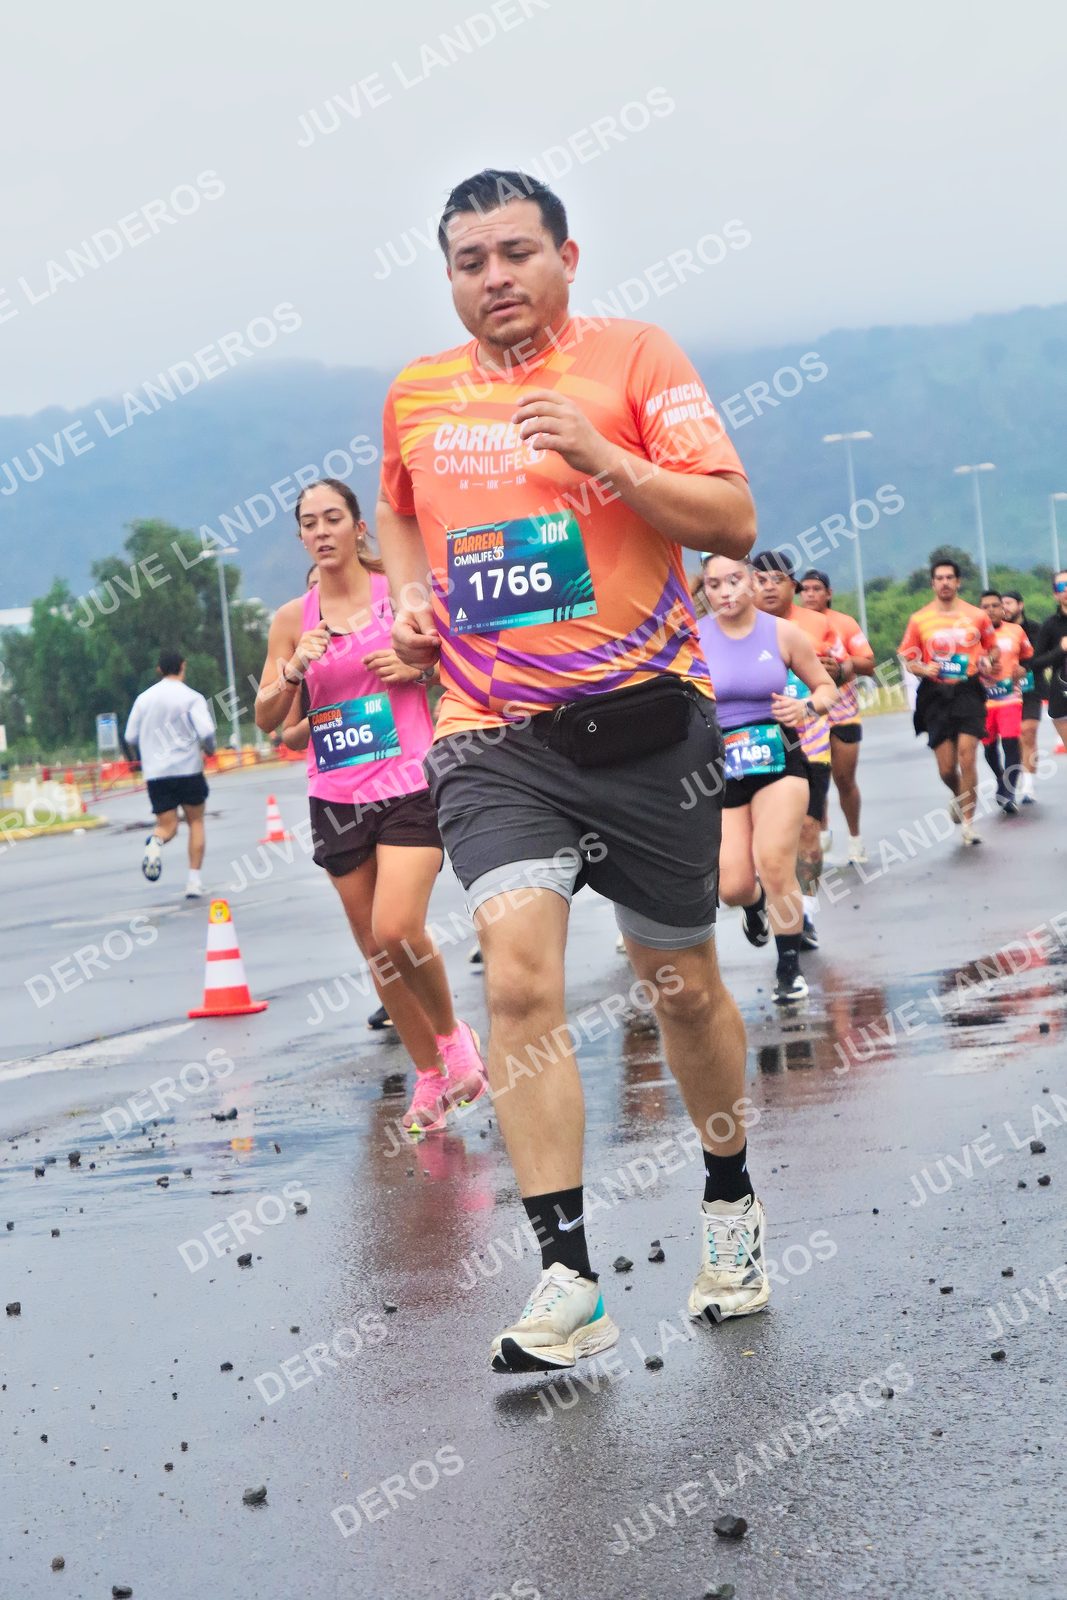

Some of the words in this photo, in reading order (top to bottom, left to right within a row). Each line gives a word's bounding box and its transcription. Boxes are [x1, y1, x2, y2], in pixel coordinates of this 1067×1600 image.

[454, 531, 504, 555] CARRERA
[540, 520, 568, 545] 10K
[469, 562, 552, 601] 1766
[364, 698, 382, 715] 10K
[323, 724, 373, 752] 1306
[732, 745, 771, 763] 1489
